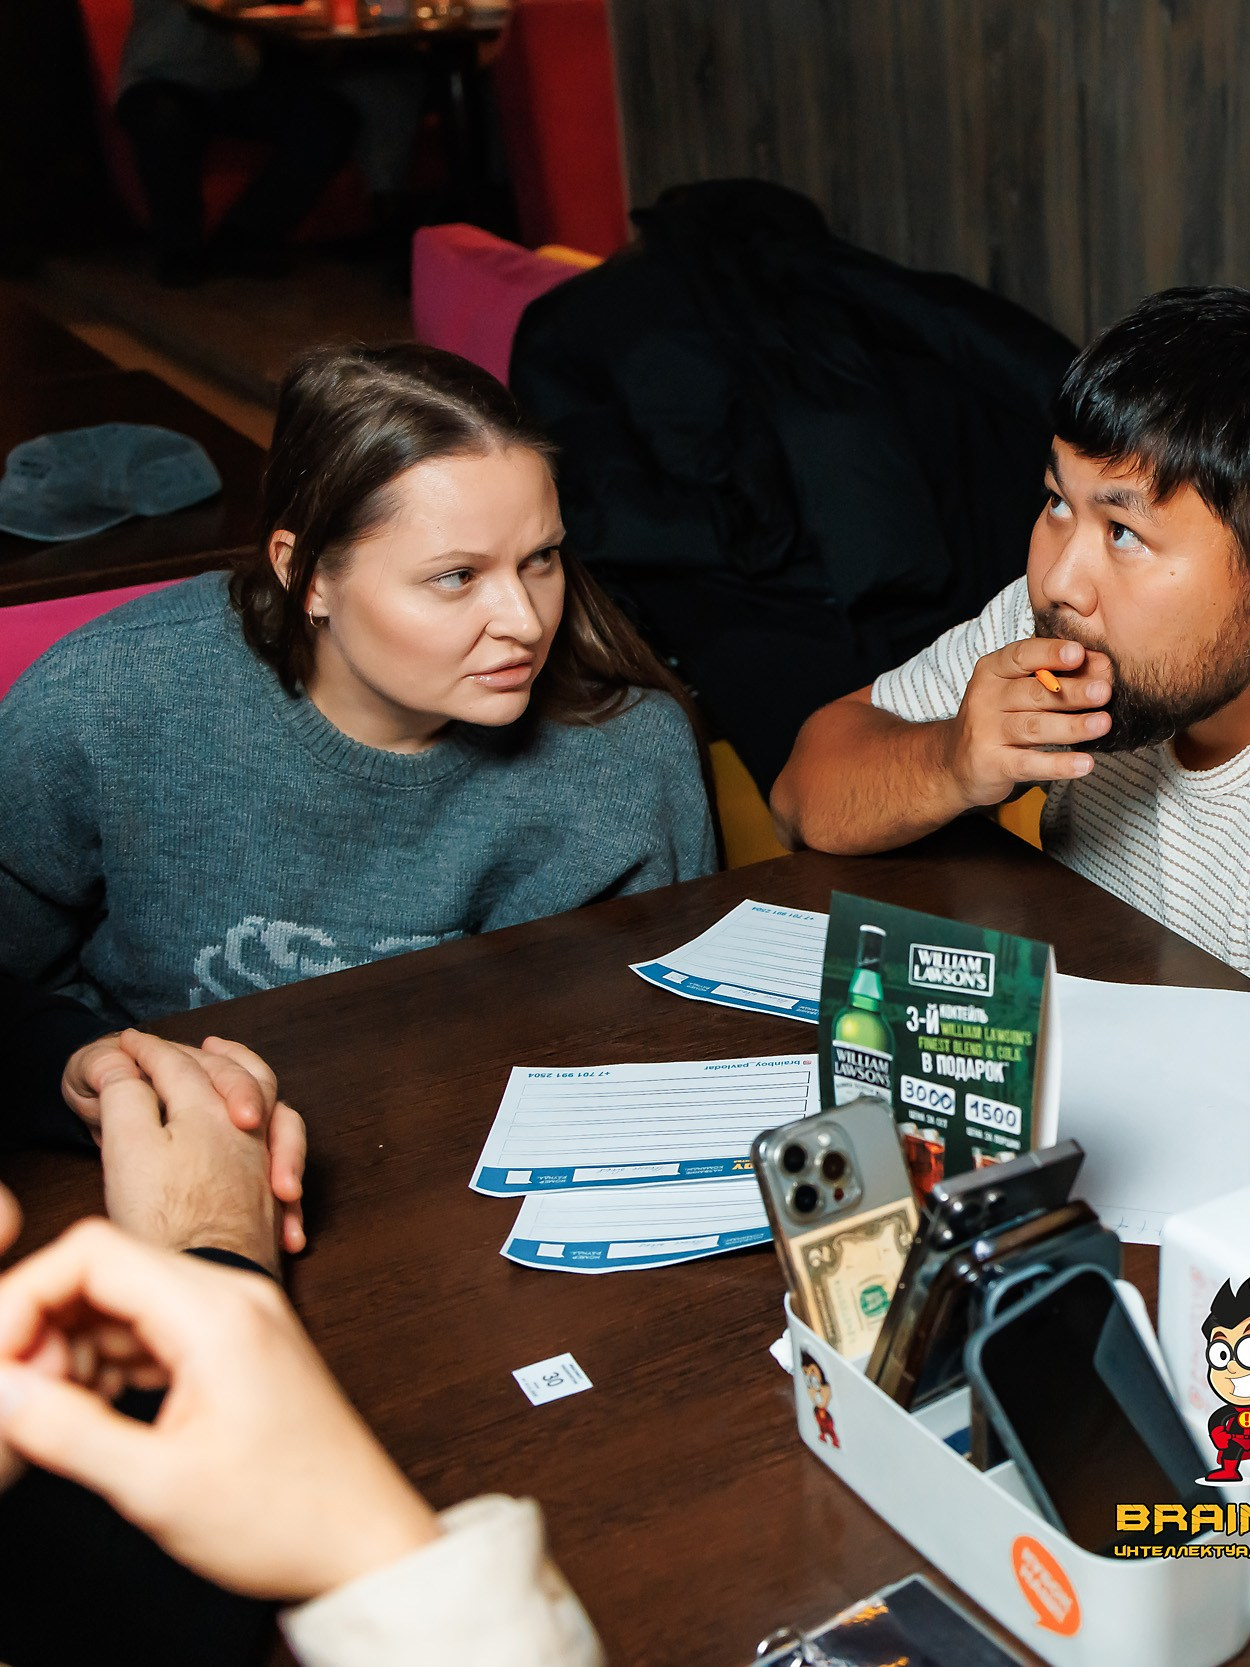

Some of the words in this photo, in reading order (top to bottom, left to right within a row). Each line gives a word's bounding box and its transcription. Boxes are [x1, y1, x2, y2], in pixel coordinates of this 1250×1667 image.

[916, 949, 982, 973] WILLIAM
[703, 1060, 801, 1071] brainboy_pavlodar
[836, 1048, 890, 1074] WILLIAM
[922, 1052, 932, 1074] В
[904, 1079, 954, 1111] 3000
[970, 1100, 1017, 1128] 1500
[542, 1372, 564, 1388] 30
